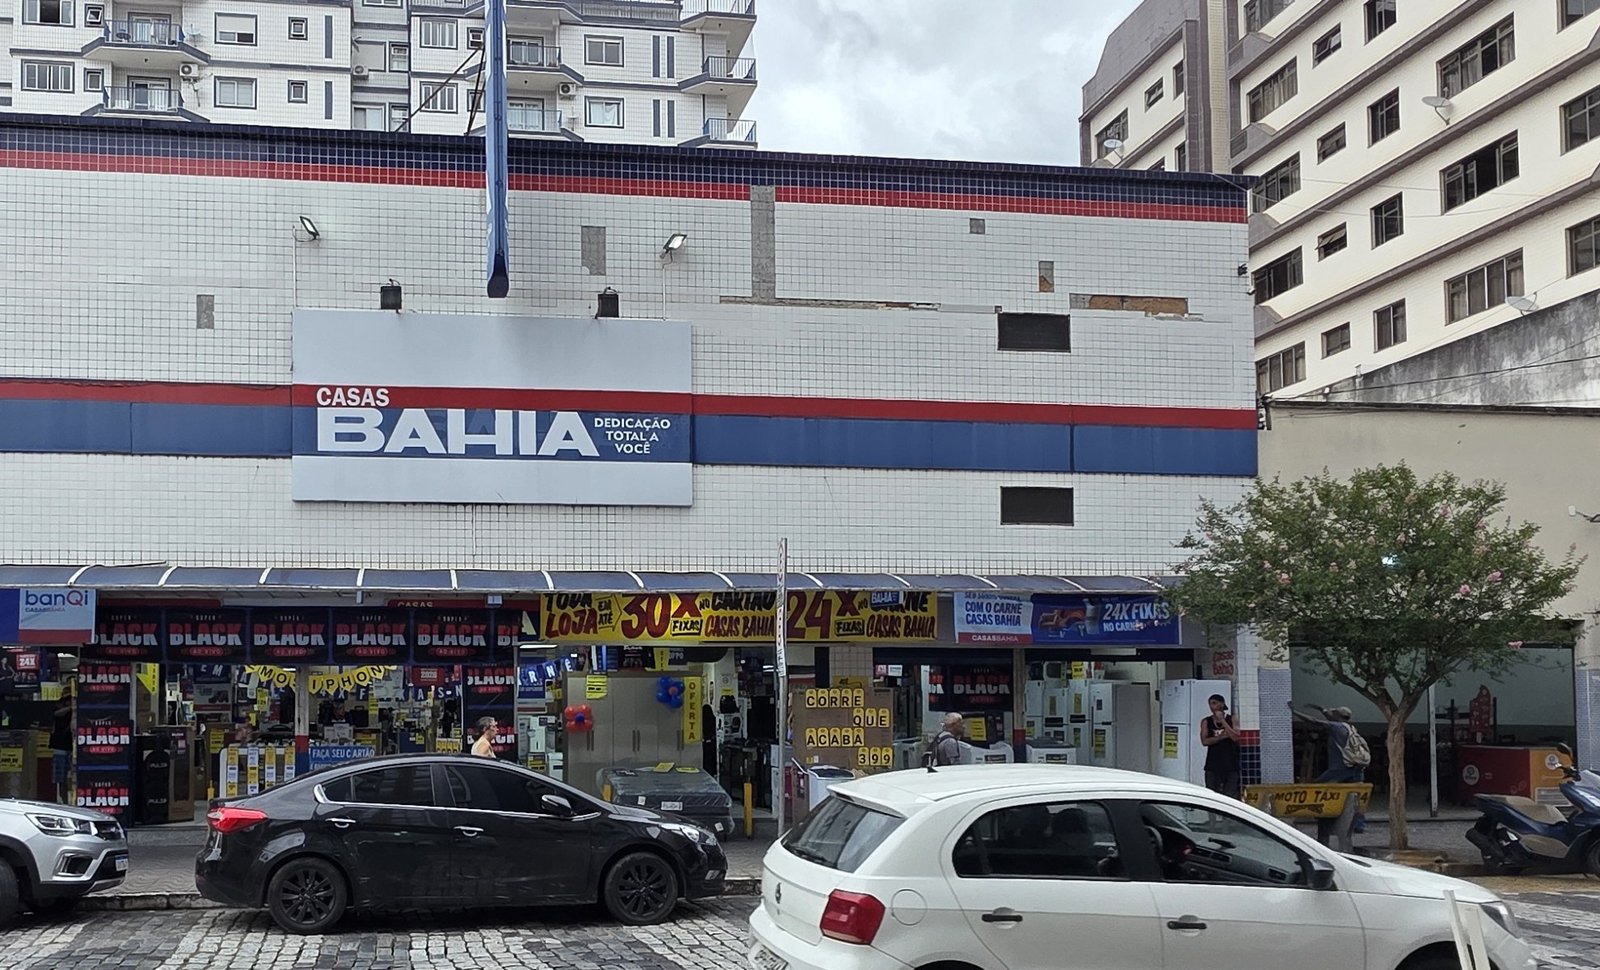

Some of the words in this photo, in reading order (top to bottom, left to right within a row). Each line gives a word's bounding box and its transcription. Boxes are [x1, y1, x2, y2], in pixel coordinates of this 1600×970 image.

[316, 387, 390, 407] CASAS
[317, 407, 600, 457] BAHIA
[594, 417, 671, 431] DEDICAÇÃO
[606, 431, 648, 441] TOTAL
[649, 432, 659, 442] A
[615, 441, 651, 454] VOCÊ
[25, 590, 88, 606] banQi
[965, 601, 984, 612] COM
[985, 602, 992, 613] O
[966, 613, 993, 625] CASAS
[995, 614, 1021, 626] BAHIA
[1103, 603, 1130, 621] 24X
[545, 608, 598, 638] LOJA
[705, 615, 741, 638] CASAS
[742, 615, 775, 637] BAHIA
[866, 614, 902, 638] CASAS
[903, 615, 936, 638] BAHIA
[1103, 621, 1114, 632] NO
[169, 623, 242, 646] BLACK
[253, 623, 325, 646] BLACK
[335, 623, 407, 646] BLACK
[416, 624, 487, 646] BLACK
[953, 675, 1011, 695] BLACK
[806, 696, 862, 706] CORRE
[688, 681, 697, 741] OFERTA
[853, 715, 887, 727] QUE
[78, 727, 130, 745] BLACK
[806, 734, 863, 745] ACABA
[312, 748, 330, 760] FAÇA
[331, 749, 345, 758] SEU
[859, 753, 891, 764] 399
[77, 787, 129, 806] BLACK
[1274, 790, 1308, 803] MOTO
